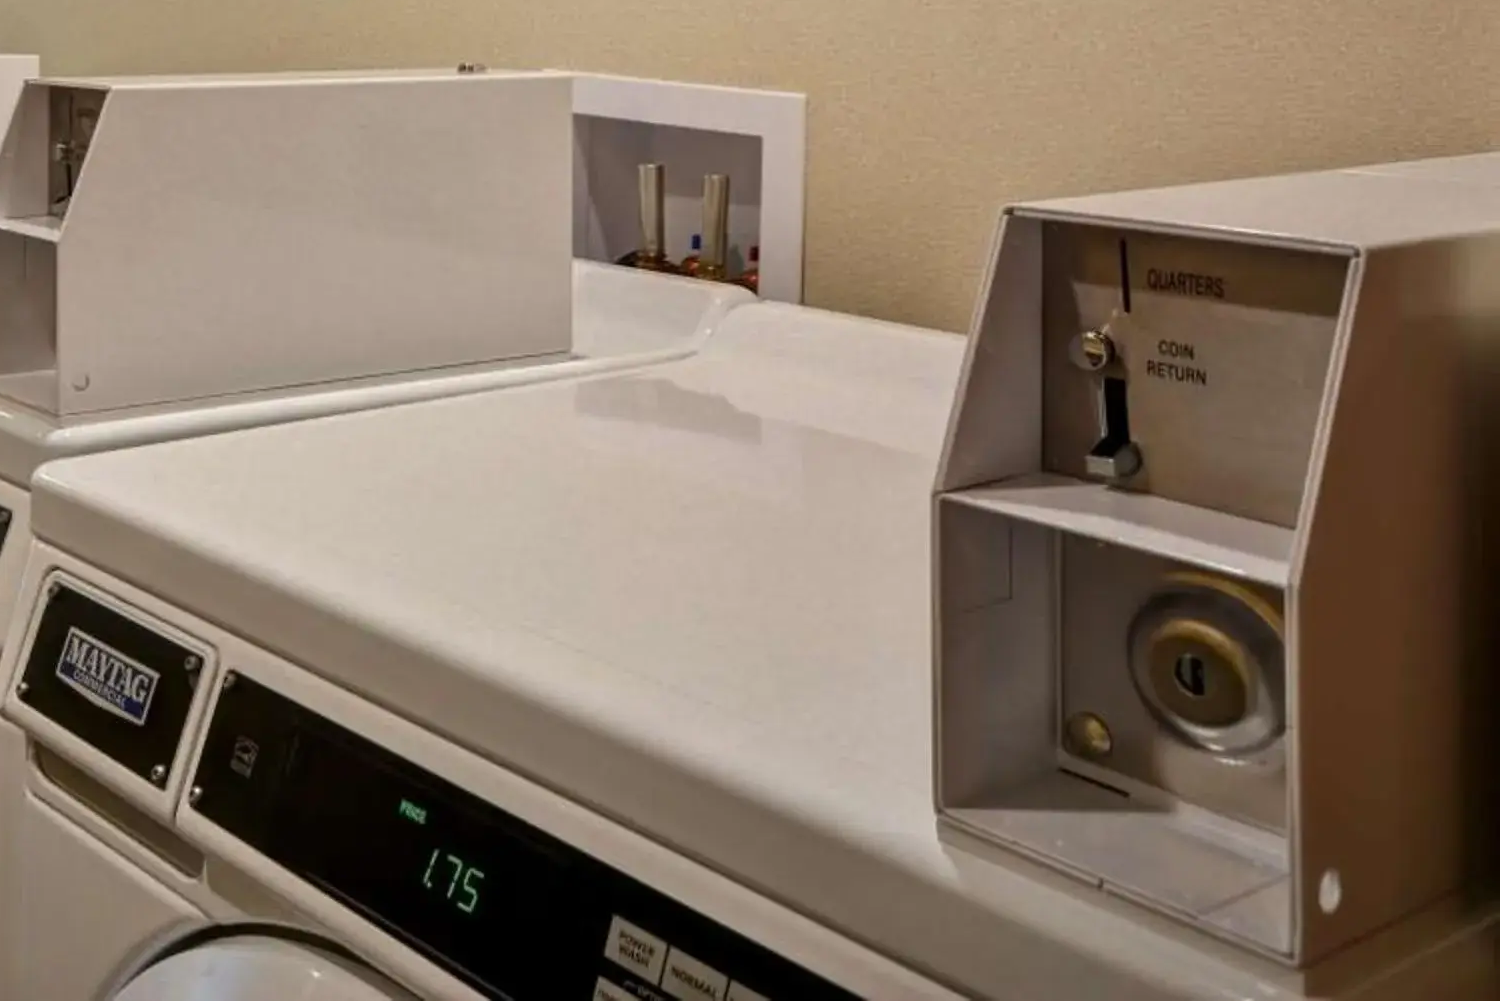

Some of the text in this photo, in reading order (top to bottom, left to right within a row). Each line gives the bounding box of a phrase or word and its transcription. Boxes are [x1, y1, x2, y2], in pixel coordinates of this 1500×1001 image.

[1146, 267, 1225, 299] QUARTERS
[1157, 339, 1196, 361] COIN
[1146, 360, 1208, 386] RETURN
[65, 636, 150, 704] MAYTAG
[669, 965, 719, 999] NORMAL
